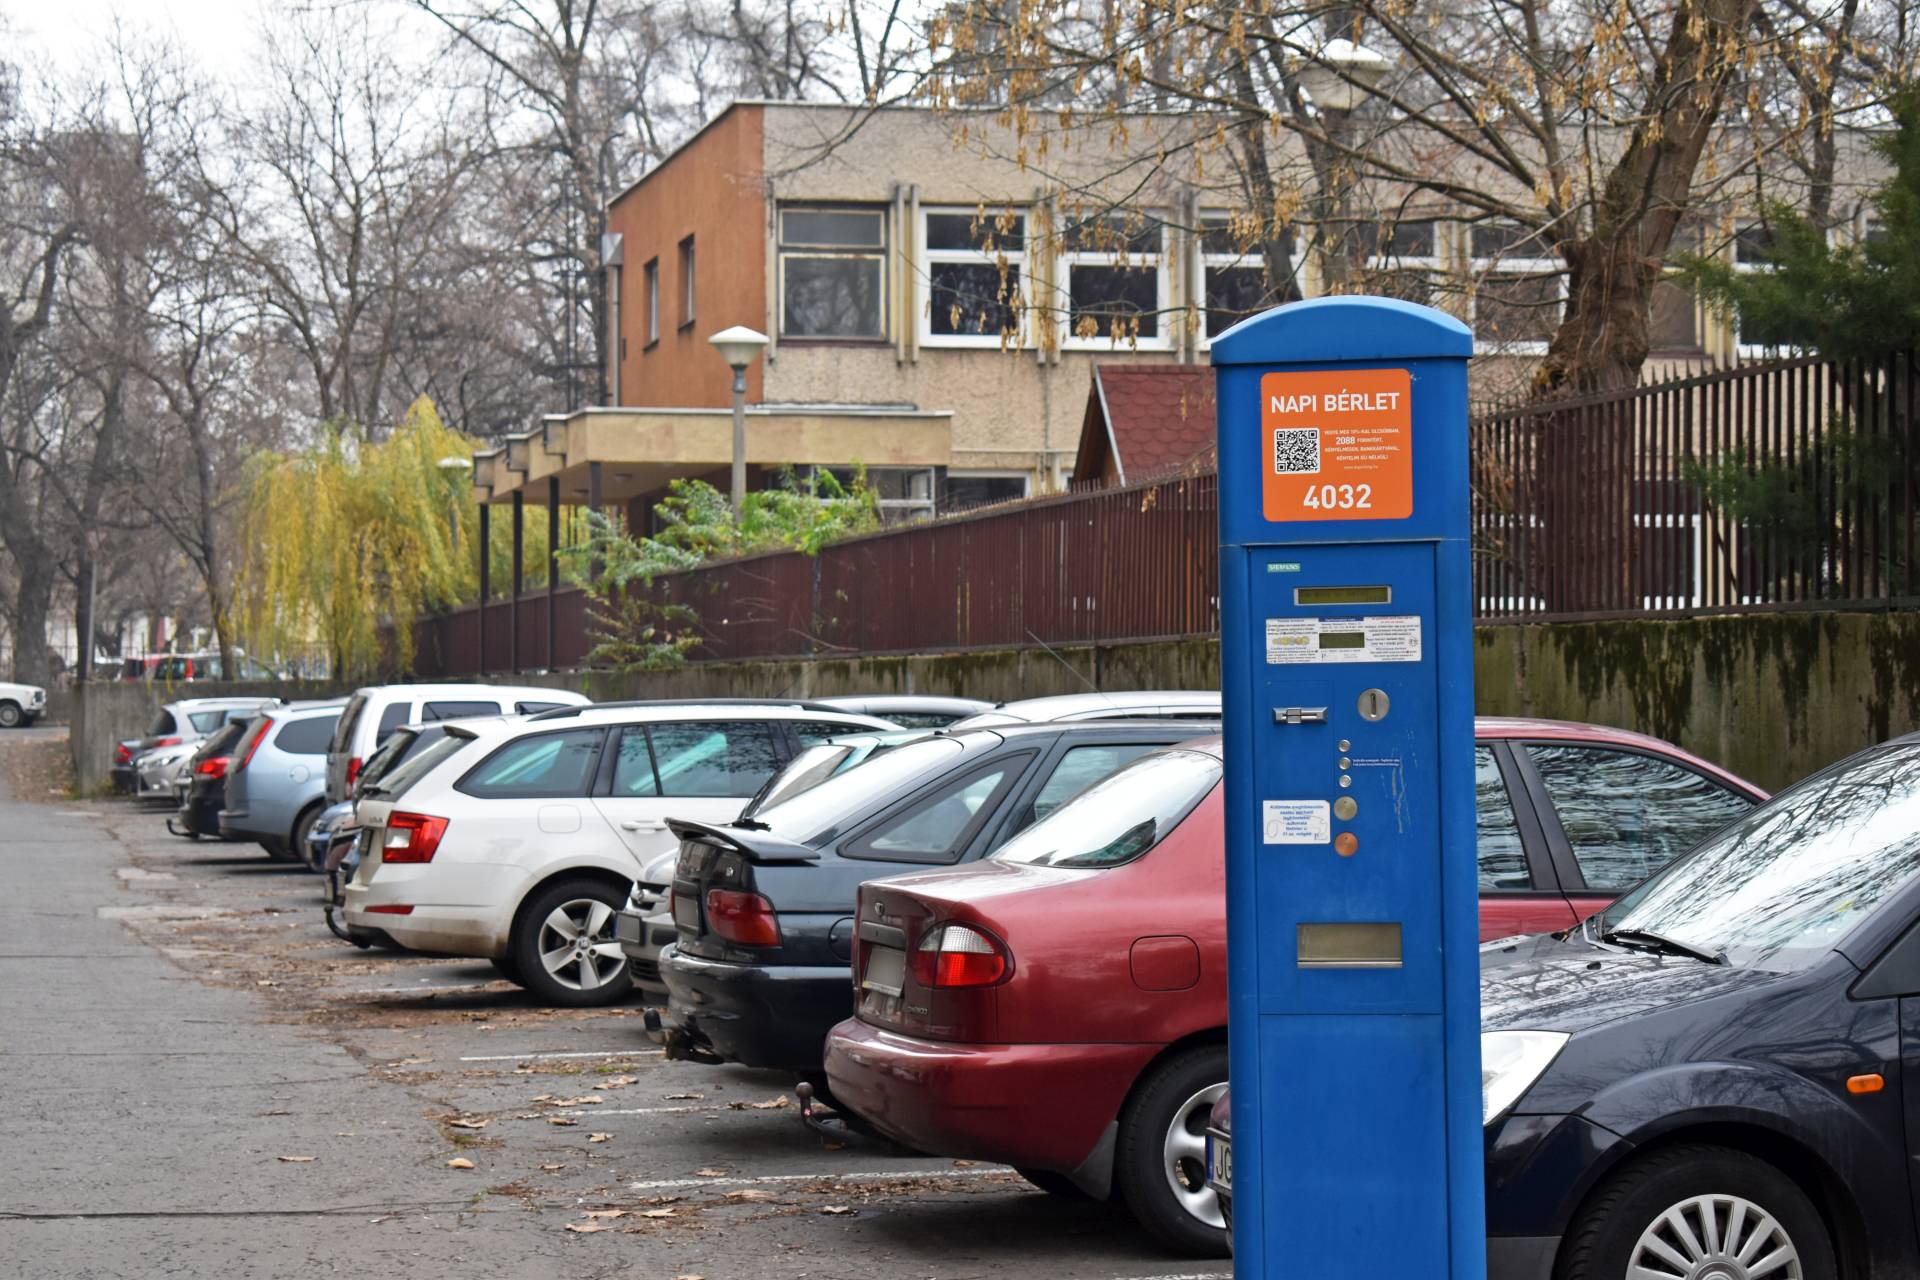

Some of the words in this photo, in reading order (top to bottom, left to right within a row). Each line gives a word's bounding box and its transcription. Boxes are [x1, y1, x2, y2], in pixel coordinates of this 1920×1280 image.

[1271, 395, 1317, 414] NAPI
[1324, 389, 1400, 412] BÉRLET
[1336, 436, 1356, 445] 2088
[1303, 484, 1372, 509] 4032
